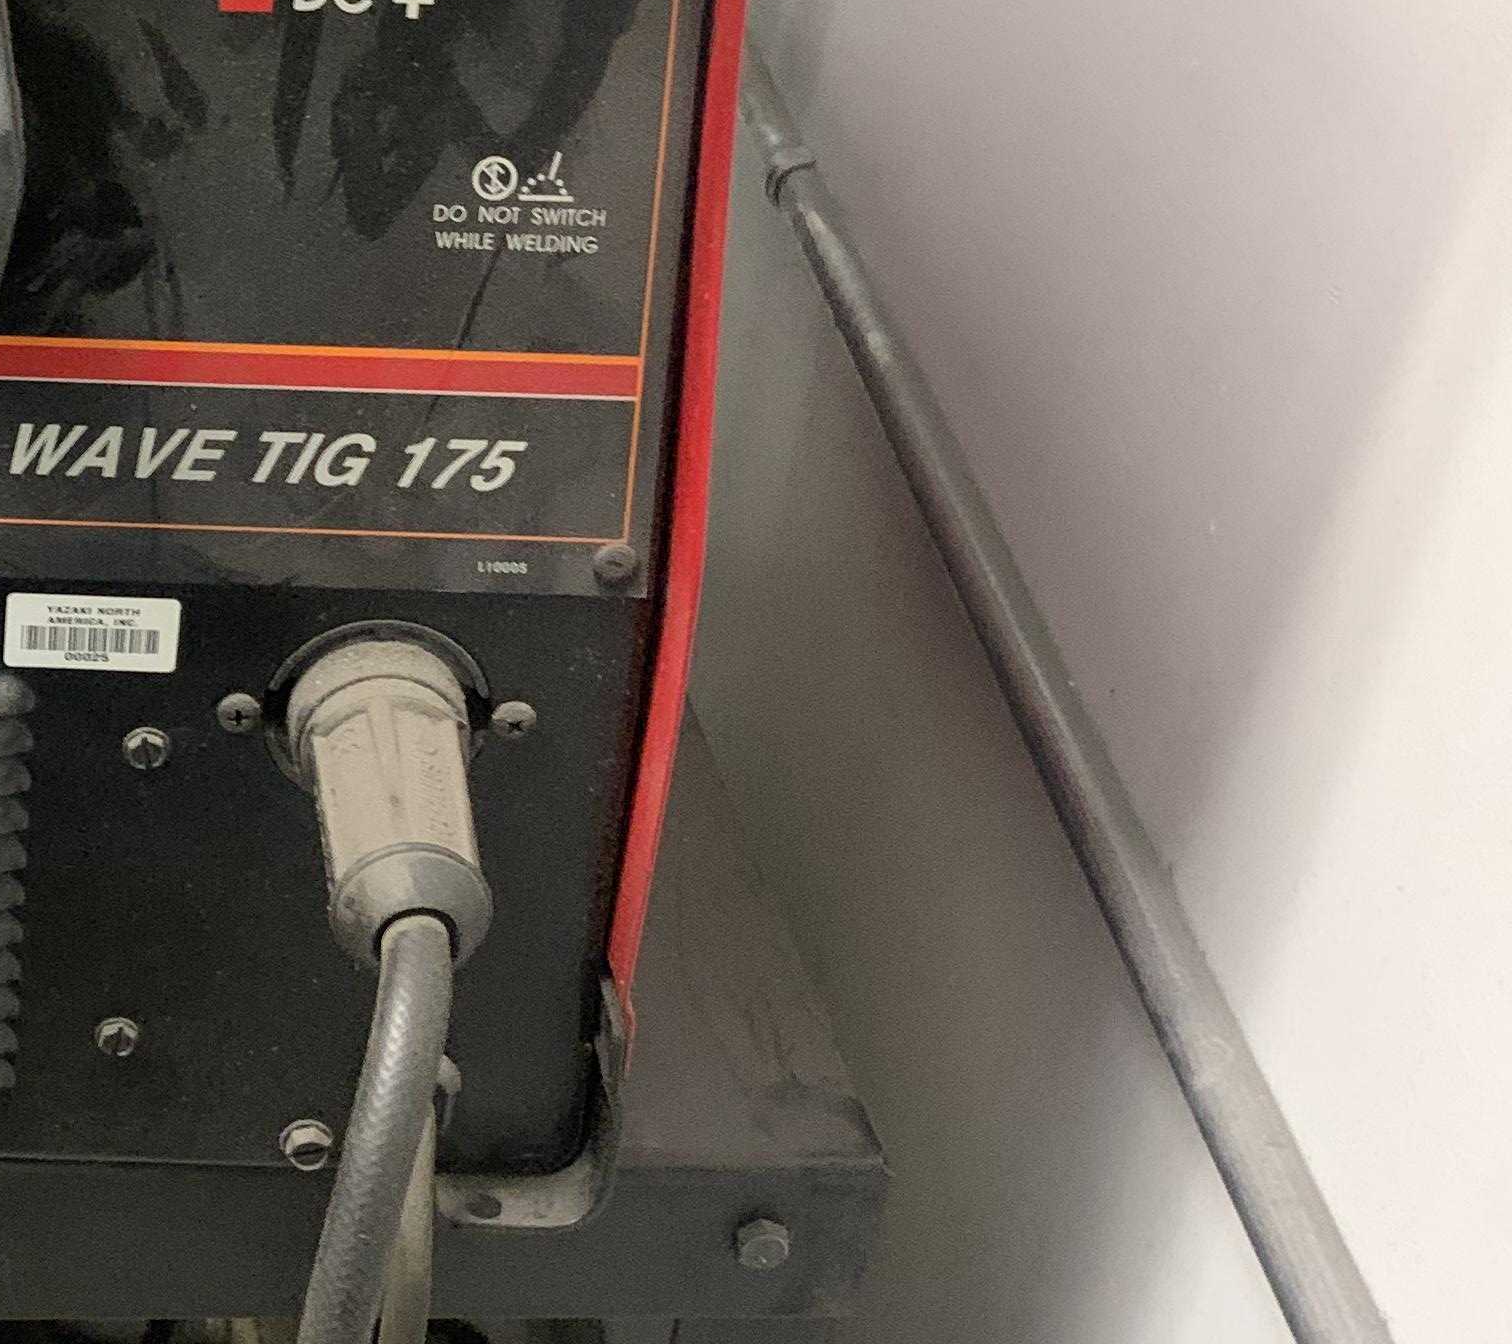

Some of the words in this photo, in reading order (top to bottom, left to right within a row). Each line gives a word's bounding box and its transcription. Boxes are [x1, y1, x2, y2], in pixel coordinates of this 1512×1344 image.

[433, 204, 467, 222] DO
[478, 206, 521, 224] NOT
[531, 207, 606, 226] SWITCH
[435, 232, 495, 250] WHILE
[506, 234, 599, 254] WELDING
[9, 424, 238, 481] WAVE
[252, 431, 376, 486] TIG
[398, 438, 528, 491] 175
[97, 608, 140, 616] NORTH
